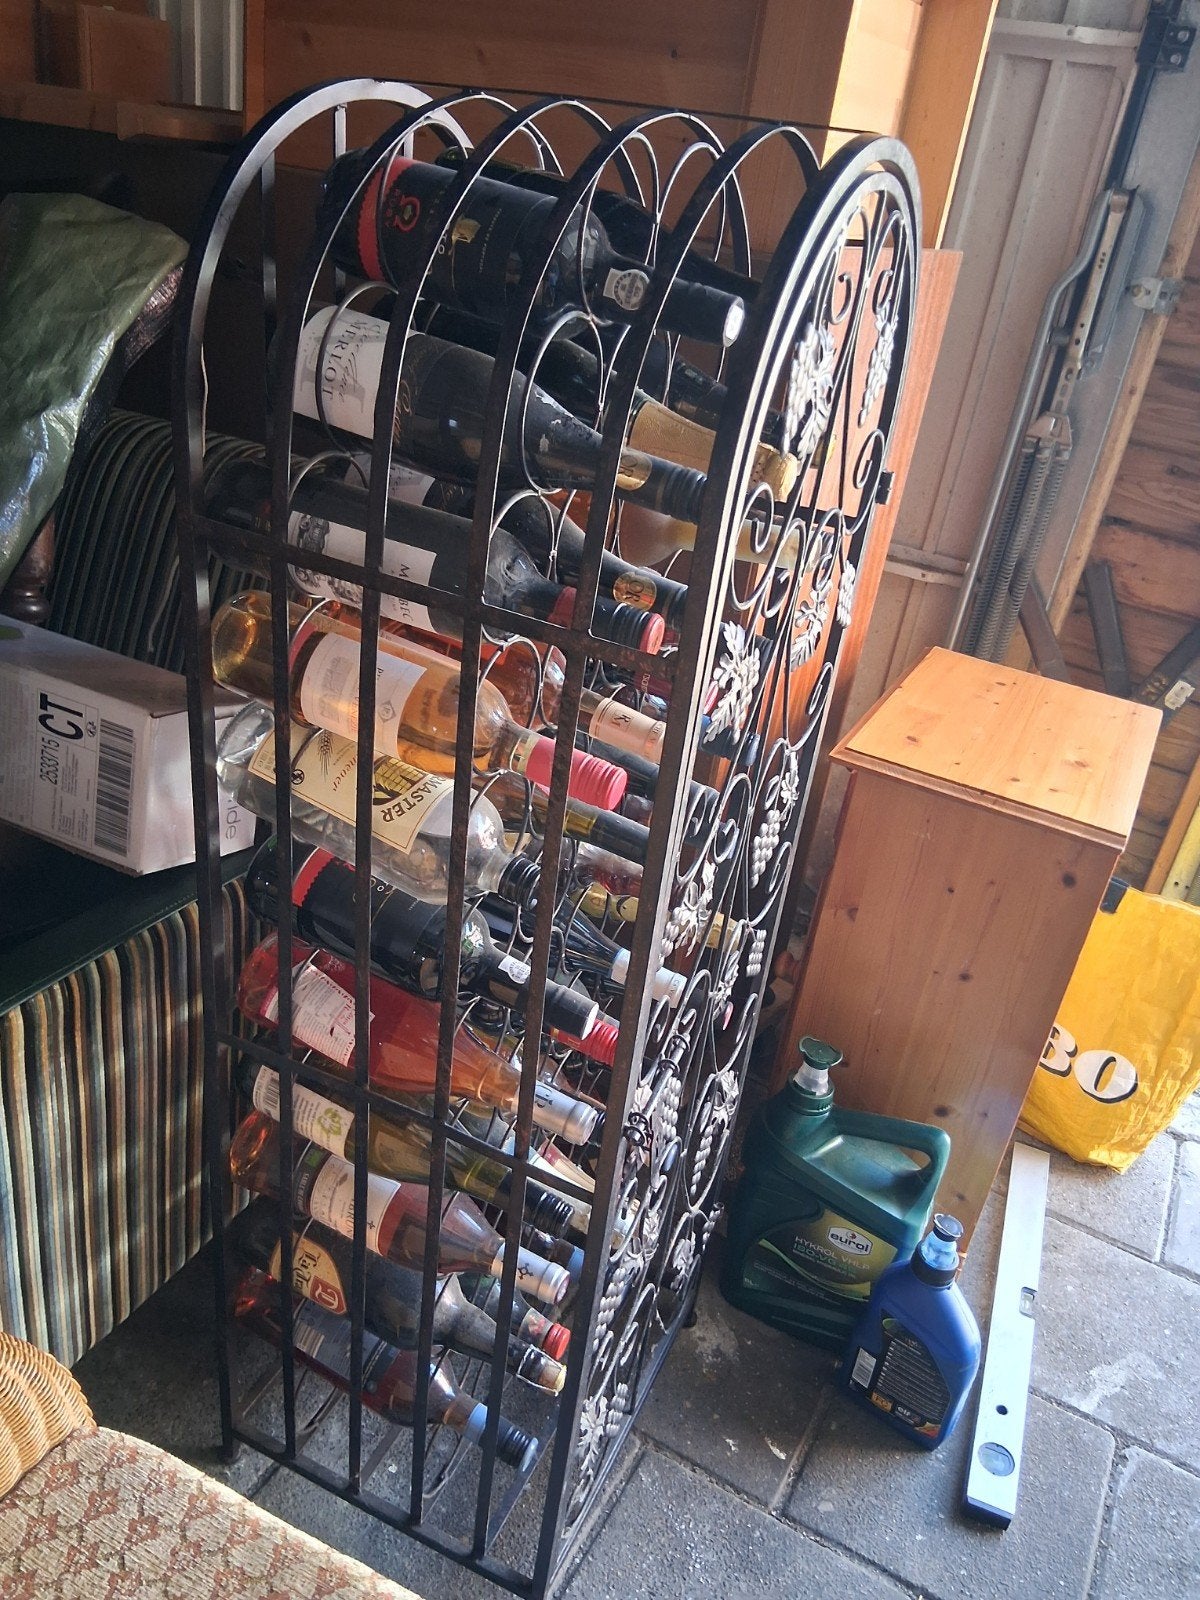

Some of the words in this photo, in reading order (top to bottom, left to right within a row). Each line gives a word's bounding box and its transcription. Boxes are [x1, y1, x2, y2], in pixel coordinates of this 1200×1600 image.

[322, 321, 368, 400] MERLOT
[399, 563, 414, 622] MBEC
[38, 692, 84, 740] CT
[39, 736, 60, 785] 2533715
[794, 1235, 838, 1260] HYKROL
[830, 1231, 869, 1253] eurol
[897, 1405, 911, 1416] elf
